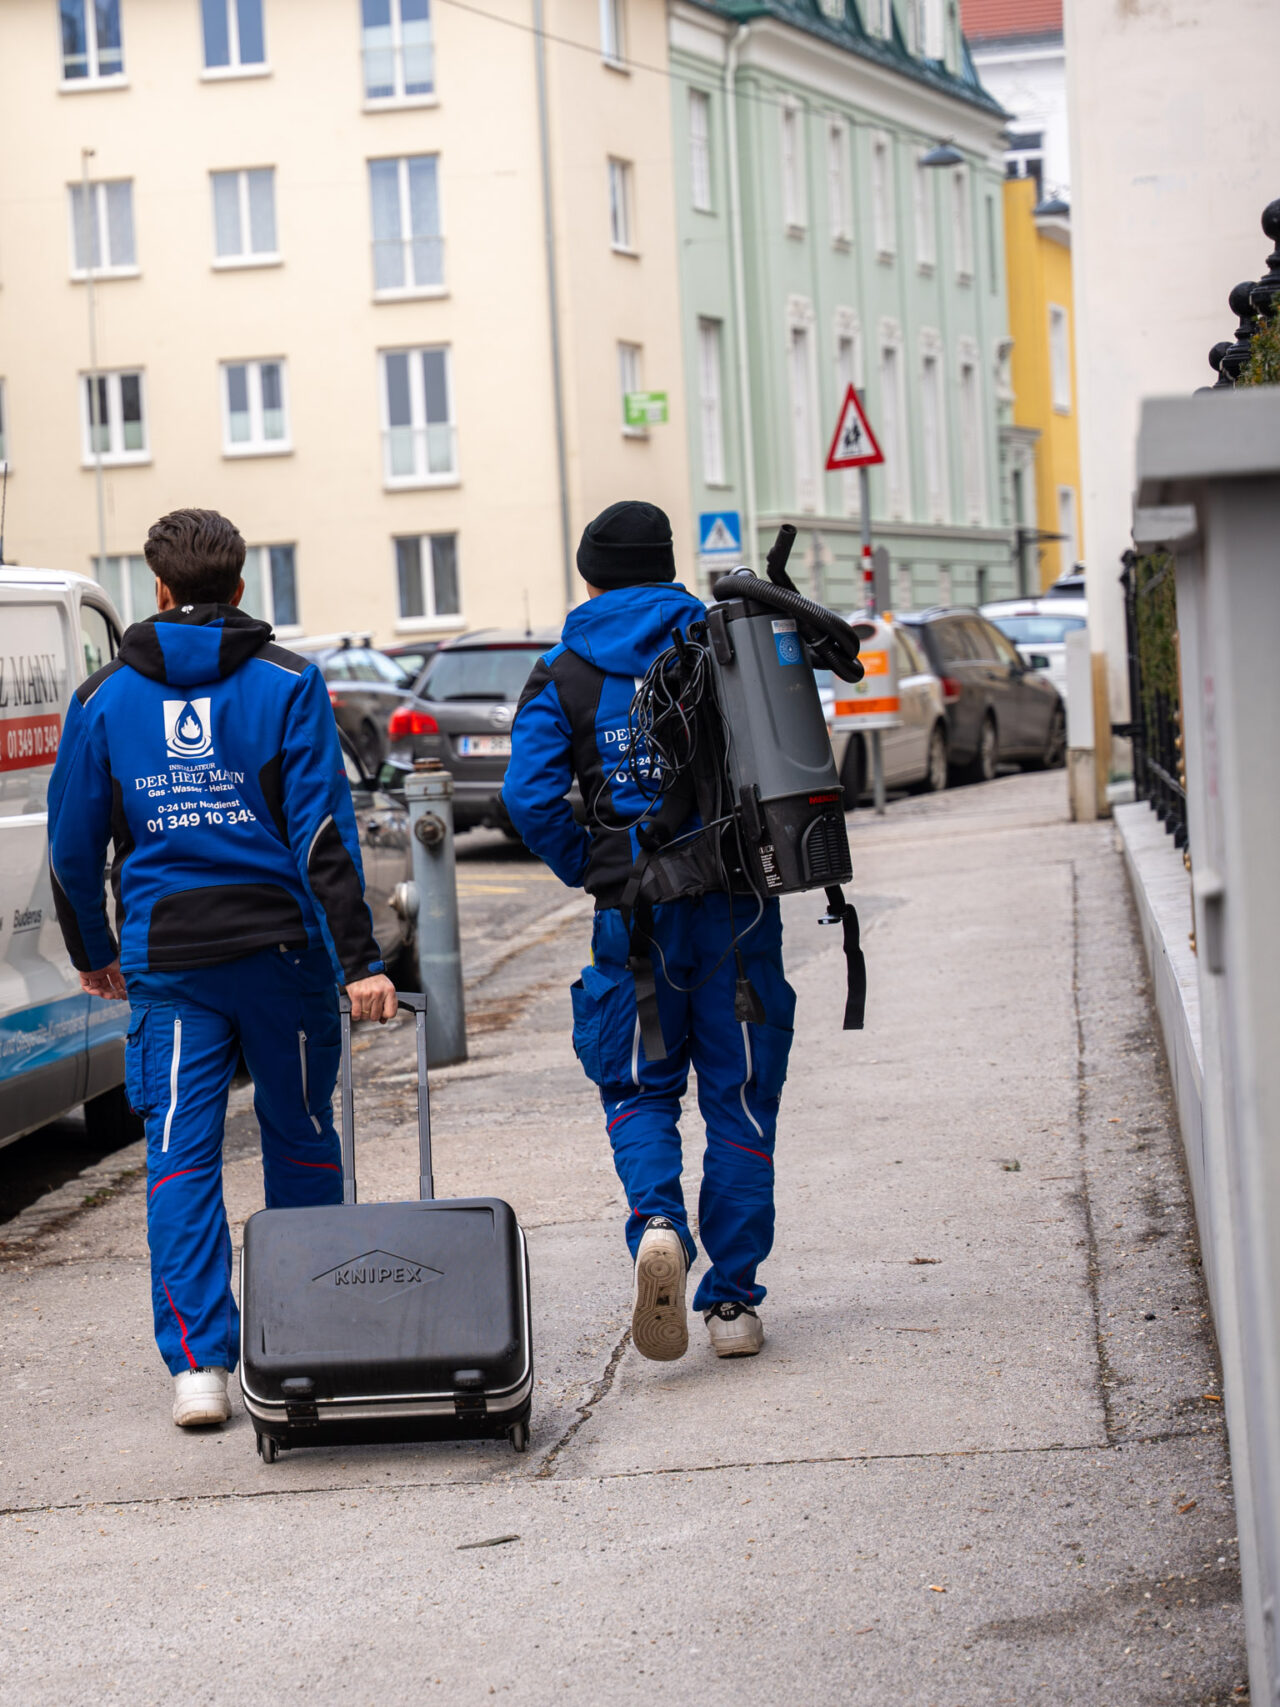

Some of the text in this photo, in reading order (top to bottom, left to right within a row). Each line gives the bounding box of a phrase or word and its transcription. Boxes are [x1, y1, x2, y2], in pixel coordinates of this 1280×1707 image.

[10, 654, 60, 707] MANN
[7, 730, 17, 759] 01
[18, 728, 33, 757] 349
[34, 727, 43, 755] 10
[44, 725, 59, 754] 349
[169, 762, 216, 772] INSTALLATEUR
[135, 769, 245, 790] DER HEIZ MANN
[148, 788, 166, 798] Gas
[171, 784, 202, 794] Wasser
[157, 799, 240, 814] 0-24 Uhr Notdienst
[147, 817, 164, 833] 01
[167, 812, 200, 829] 349
[205, 811, 224, 825] 10
[334, 1267, 422, 1286] KNIPEX
